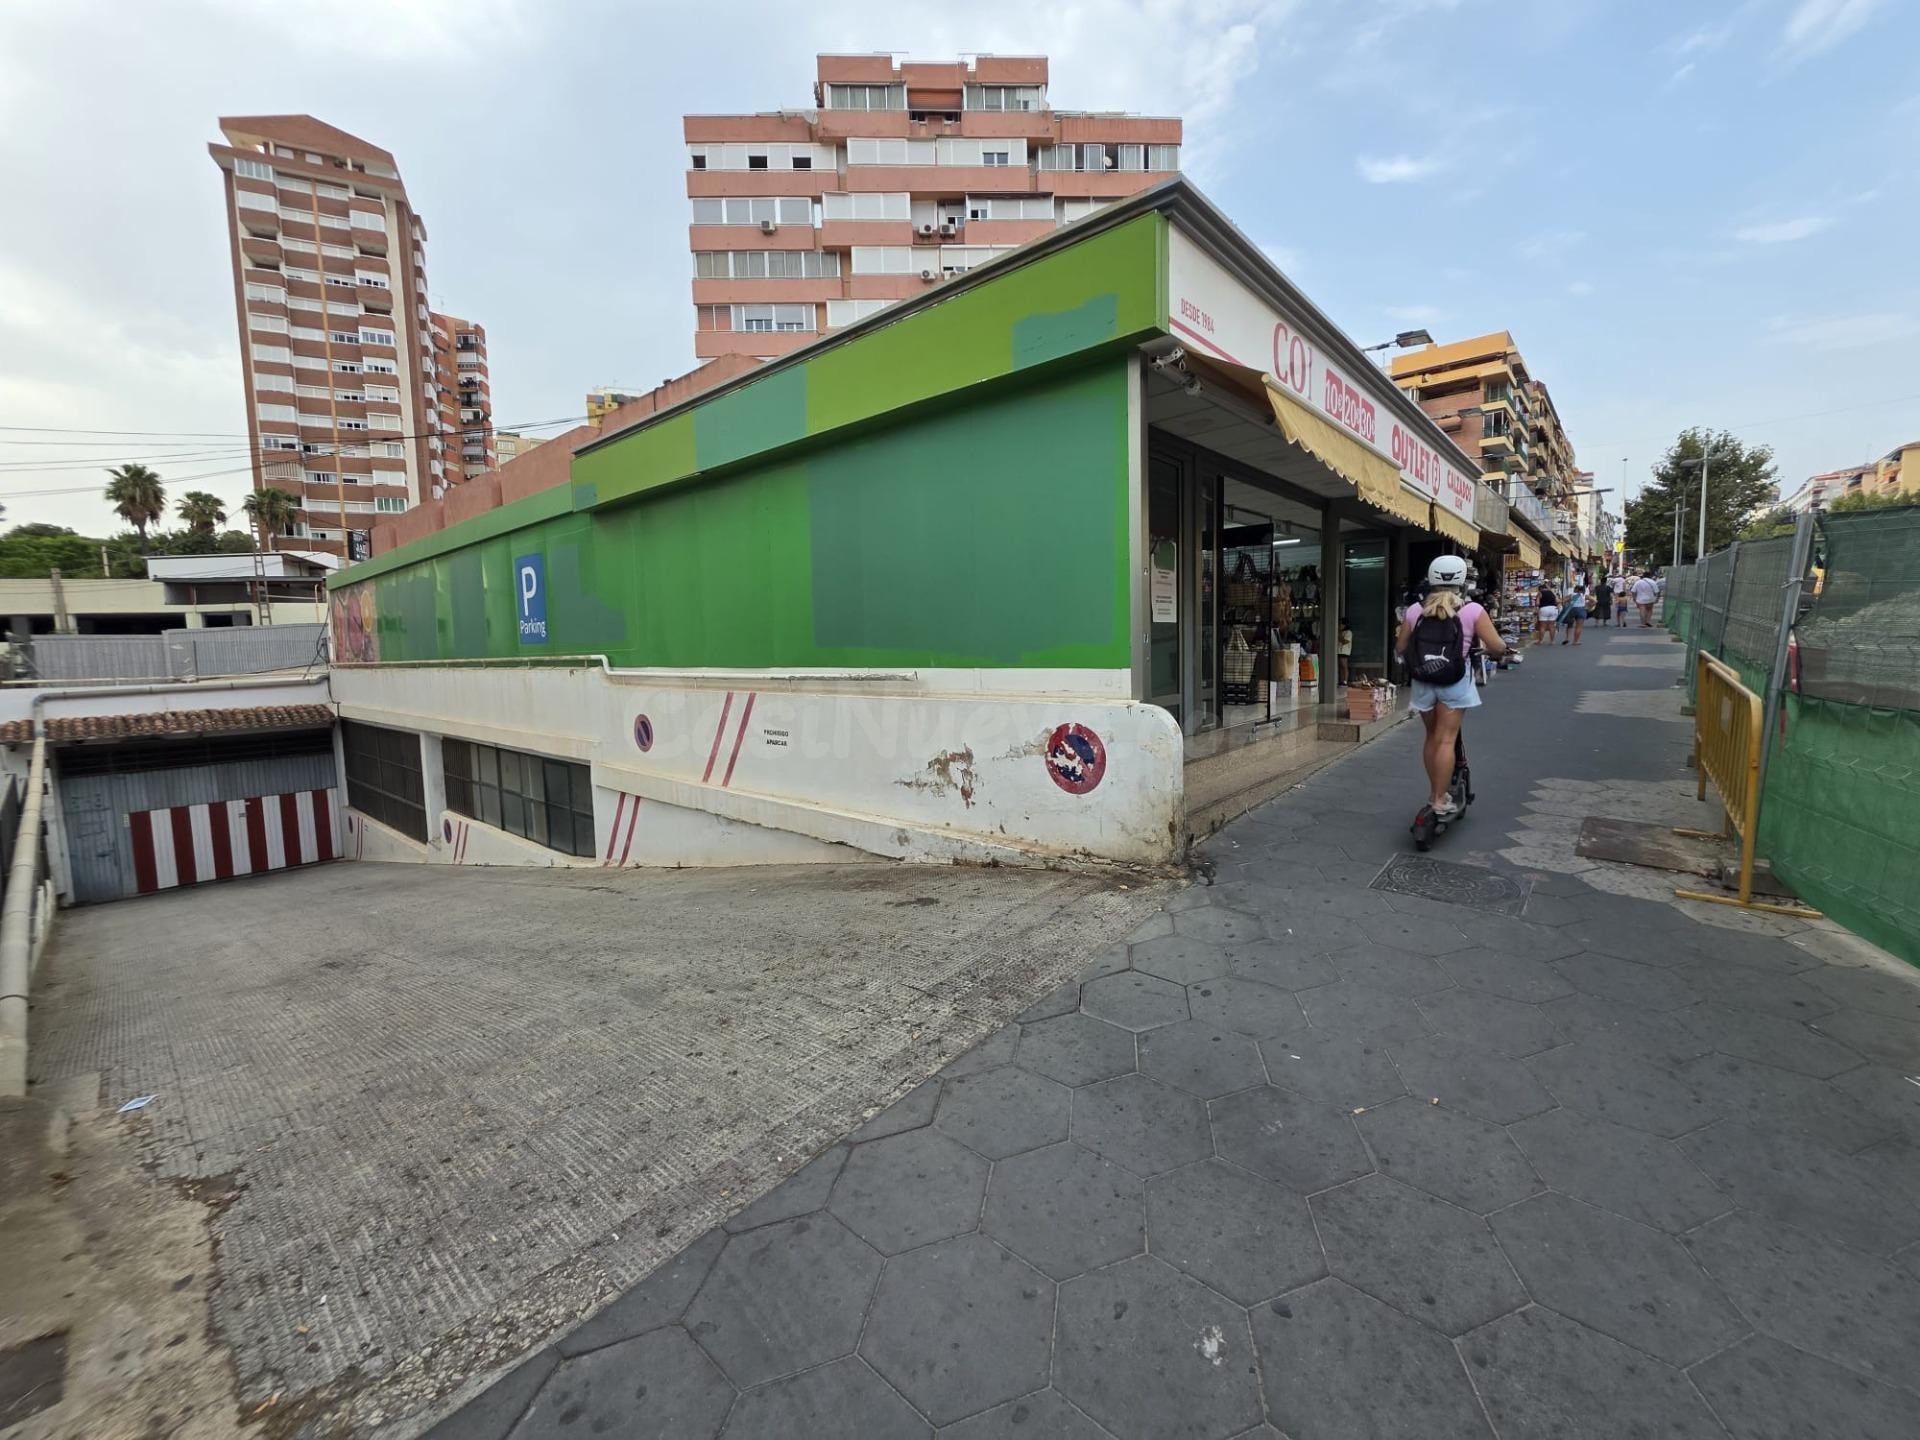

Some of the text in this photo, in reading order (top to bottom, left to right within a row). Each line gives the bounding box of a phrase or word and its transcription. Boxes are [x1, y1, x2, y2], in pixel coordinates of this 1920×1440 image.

[1181, 298, 1200, 325] DESDE
[1391, 424, 1430, 485] OUTLET
[1447, 469, 1472, 502] CALZADOS
[522, 566, 537, 616] P
[520, 618, 546, 637] Parking
[763, 729, 789, 737] PROHIBIDO
